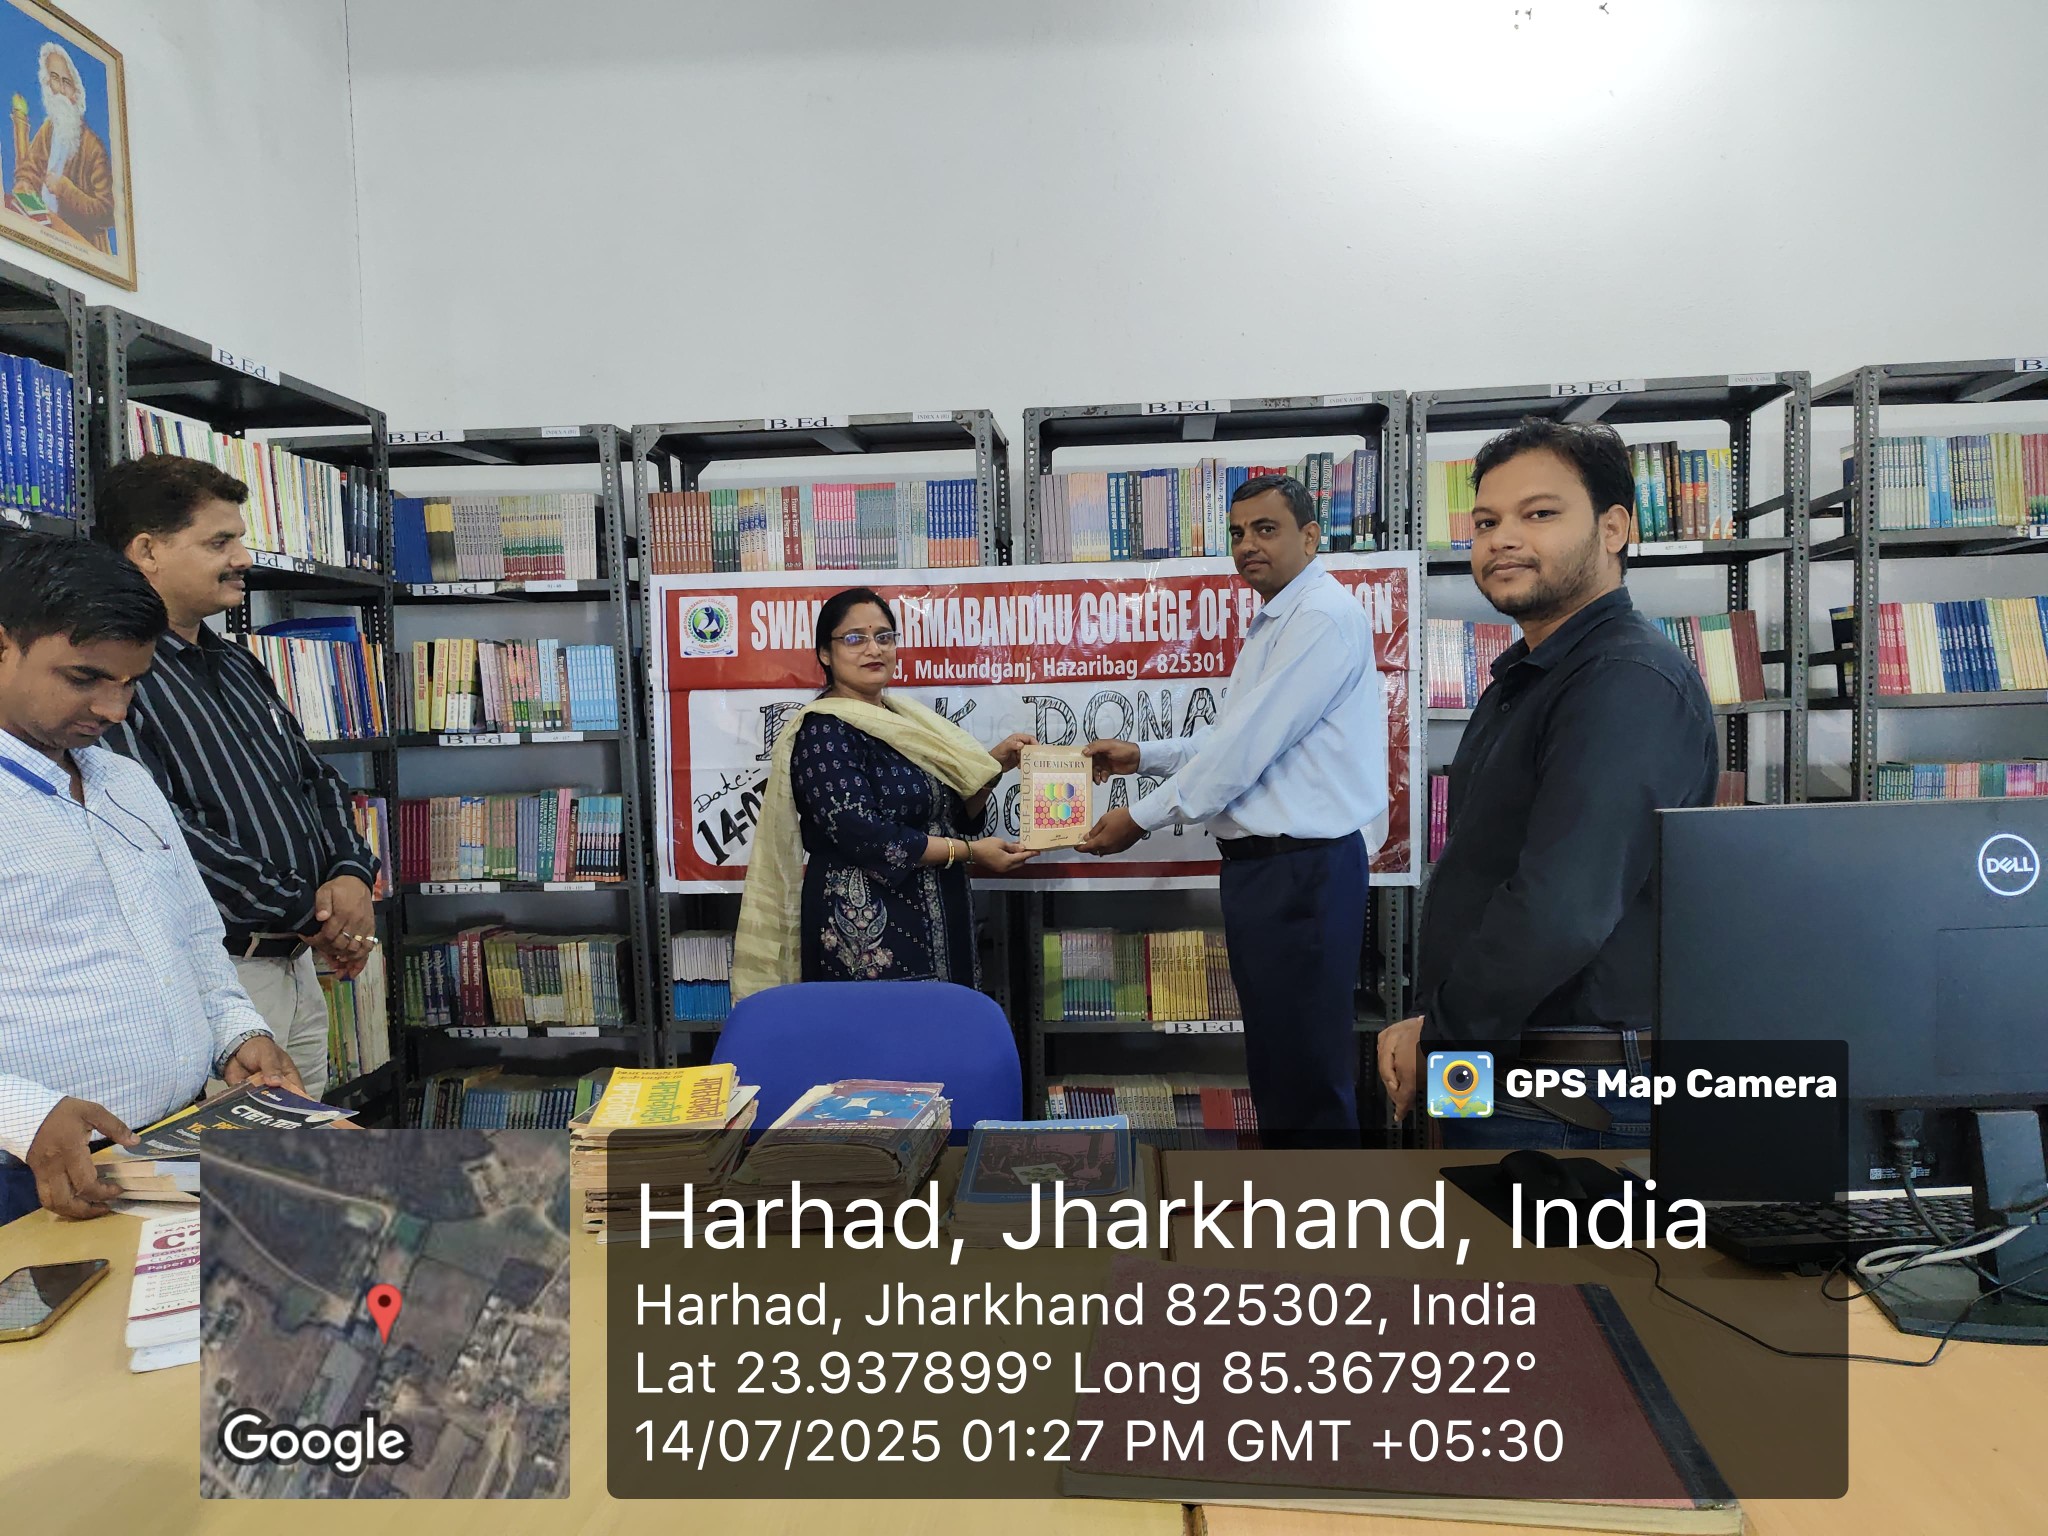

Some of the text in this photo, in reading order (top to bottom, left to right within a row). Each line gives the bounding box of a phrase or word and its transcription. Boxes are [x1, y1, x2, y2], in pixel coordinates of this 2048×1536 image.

[218, 348, 271, 381] B.Ed.
[2021, 359, 2048, 371] B.
[1558, 380, 1629, 395] B.Ed.
[1147, 400, 1216, 414] B.Ed.
[769, 416, 834, 429] B.Ed.
[388, 431, 450, 443] B.Ed.
[254, 551, 284, 568] Ed.
[422, 584, 483, 594] B.Ed.
[895, 592, 1073, 648] ARMABANDHU
[1080, 589, 1193, 643] COLLEGE
[1199, 587, 1233, 641] OF
[915, 657, 1036, 684] Mukundganj,
[1043, 654, 1138, 680] Hazaribag
[1157, 652, 1224, 675] 825301
[1022, 687, 1227, 747] DONA
[1033, 760, 1086, 768] CHEMISTRY
[1022, 752, 1031, 842] SELF-TUTOR
[1986, 856, 2034, 874] DELL
[1174, 1021, 1241, 1033] B.Ed.
[231, 1104, 273, 1123] CTET
[147, 1260, 185, 1271] Paper
